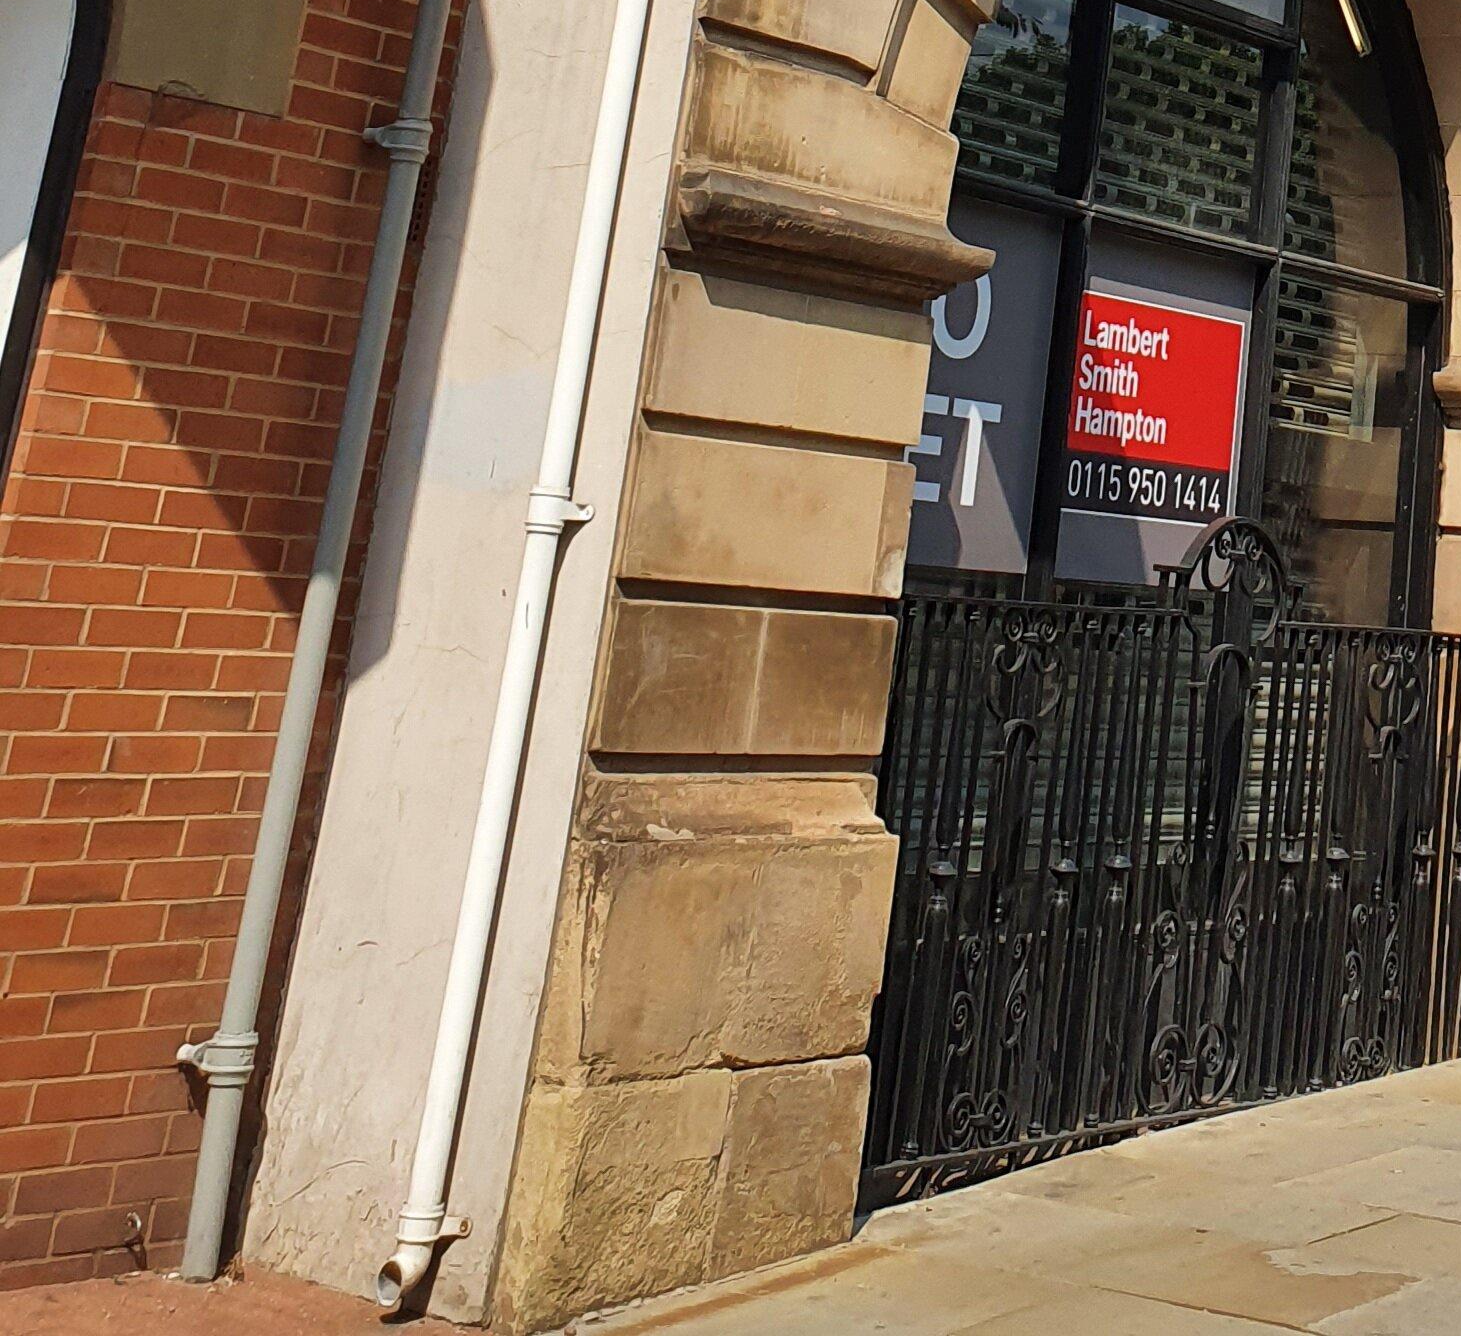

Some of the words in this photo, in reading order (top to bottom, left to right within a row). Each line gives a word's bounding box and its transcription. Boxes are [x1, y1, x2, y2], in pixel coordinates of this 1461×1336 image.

[1083, 309, 1170, 361] Lambert
[1078, 352, 1140, 398] Smith
[1074, 395, 1168, 447] Hampton
[1067, 459, 1123, 502] 0115
[1127, 466, 1167, 508] 950
[1173, 473, 1222, 514] 1414
